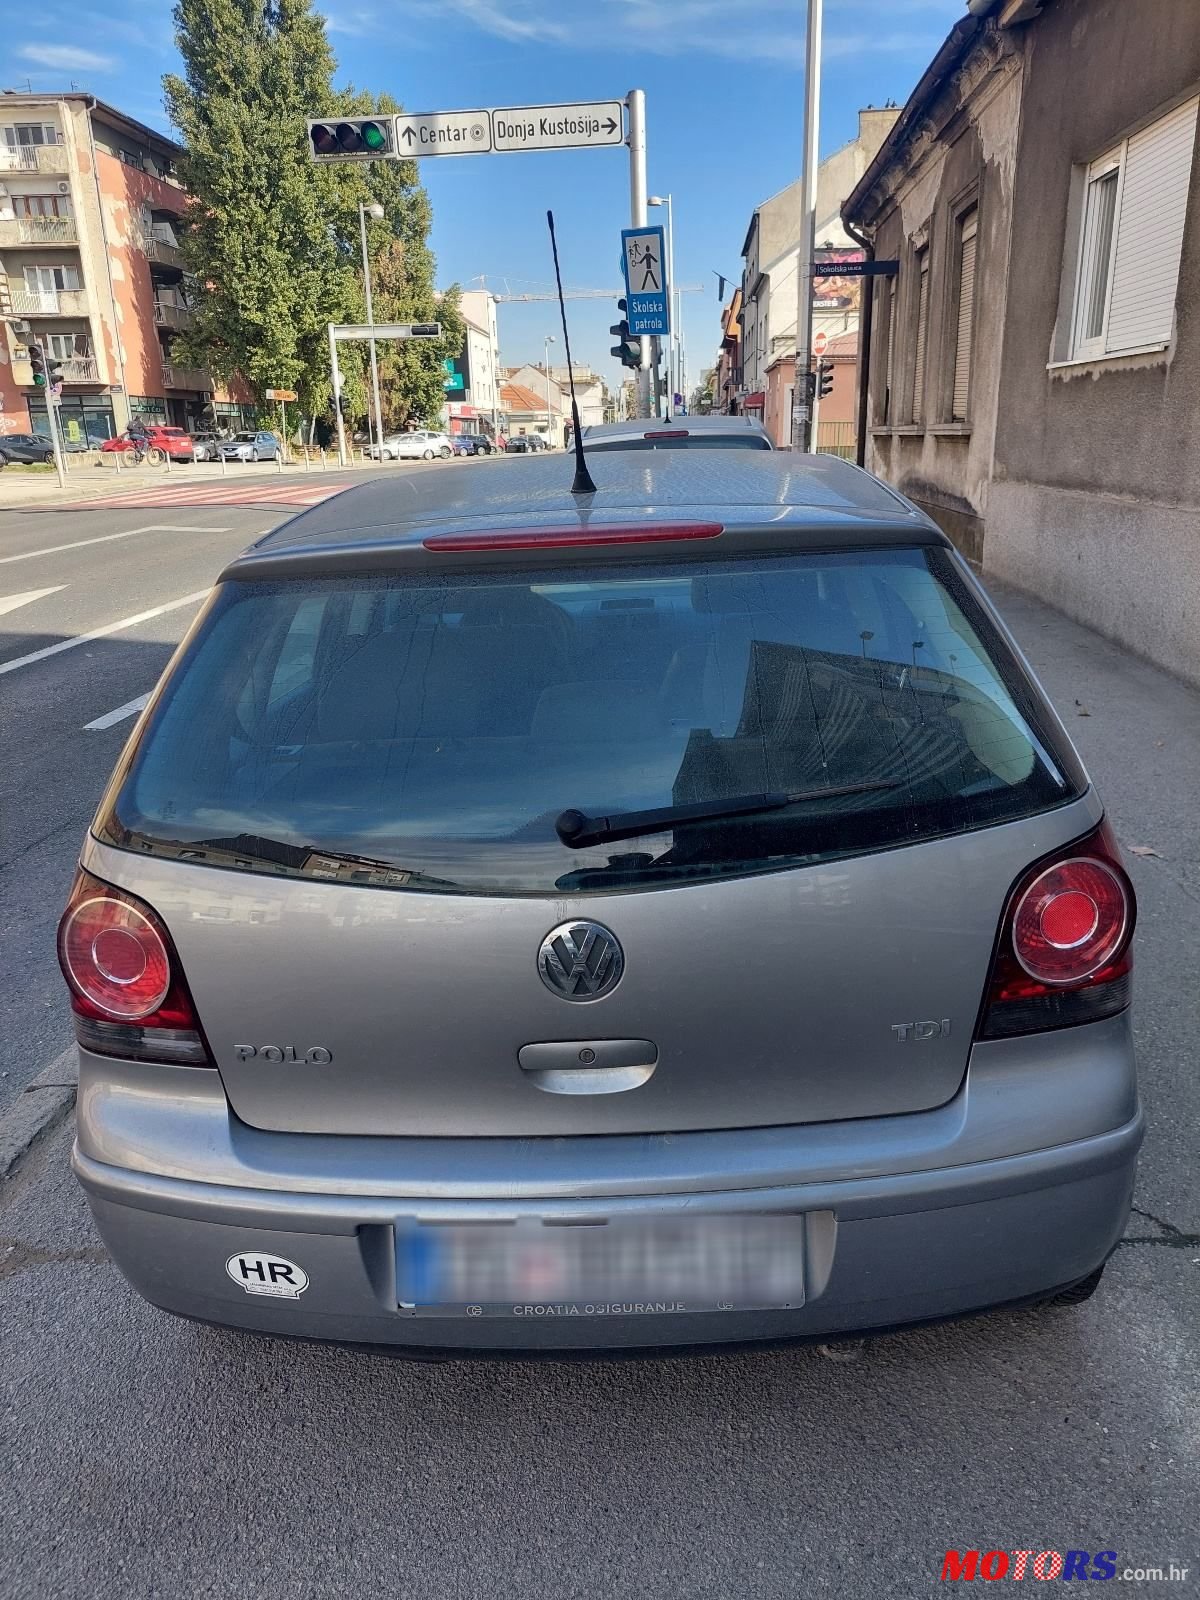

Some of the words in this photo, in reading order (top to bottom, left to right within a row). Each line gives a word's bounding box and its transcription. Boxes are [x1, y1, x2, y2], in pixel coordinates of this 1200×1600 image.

[419, 125, 468, 144] Centar
[497, 119, 535, 142] Donja
[539, 115, 600, 139] Kustošija
[819, 264, 847, 274] Sokolska
[632, 298, 663, 313] Školska
[635, 317, 663, 332] patrola
[891, 1018, 951, 1042] TDI
[233, 1044, 333, 1065] POLO
[239, 1258, 298, 1286] HR
[513, 1304, 580, 1316] CROATIA
[584, 1301, 687, 1315] OSIGURANJE
